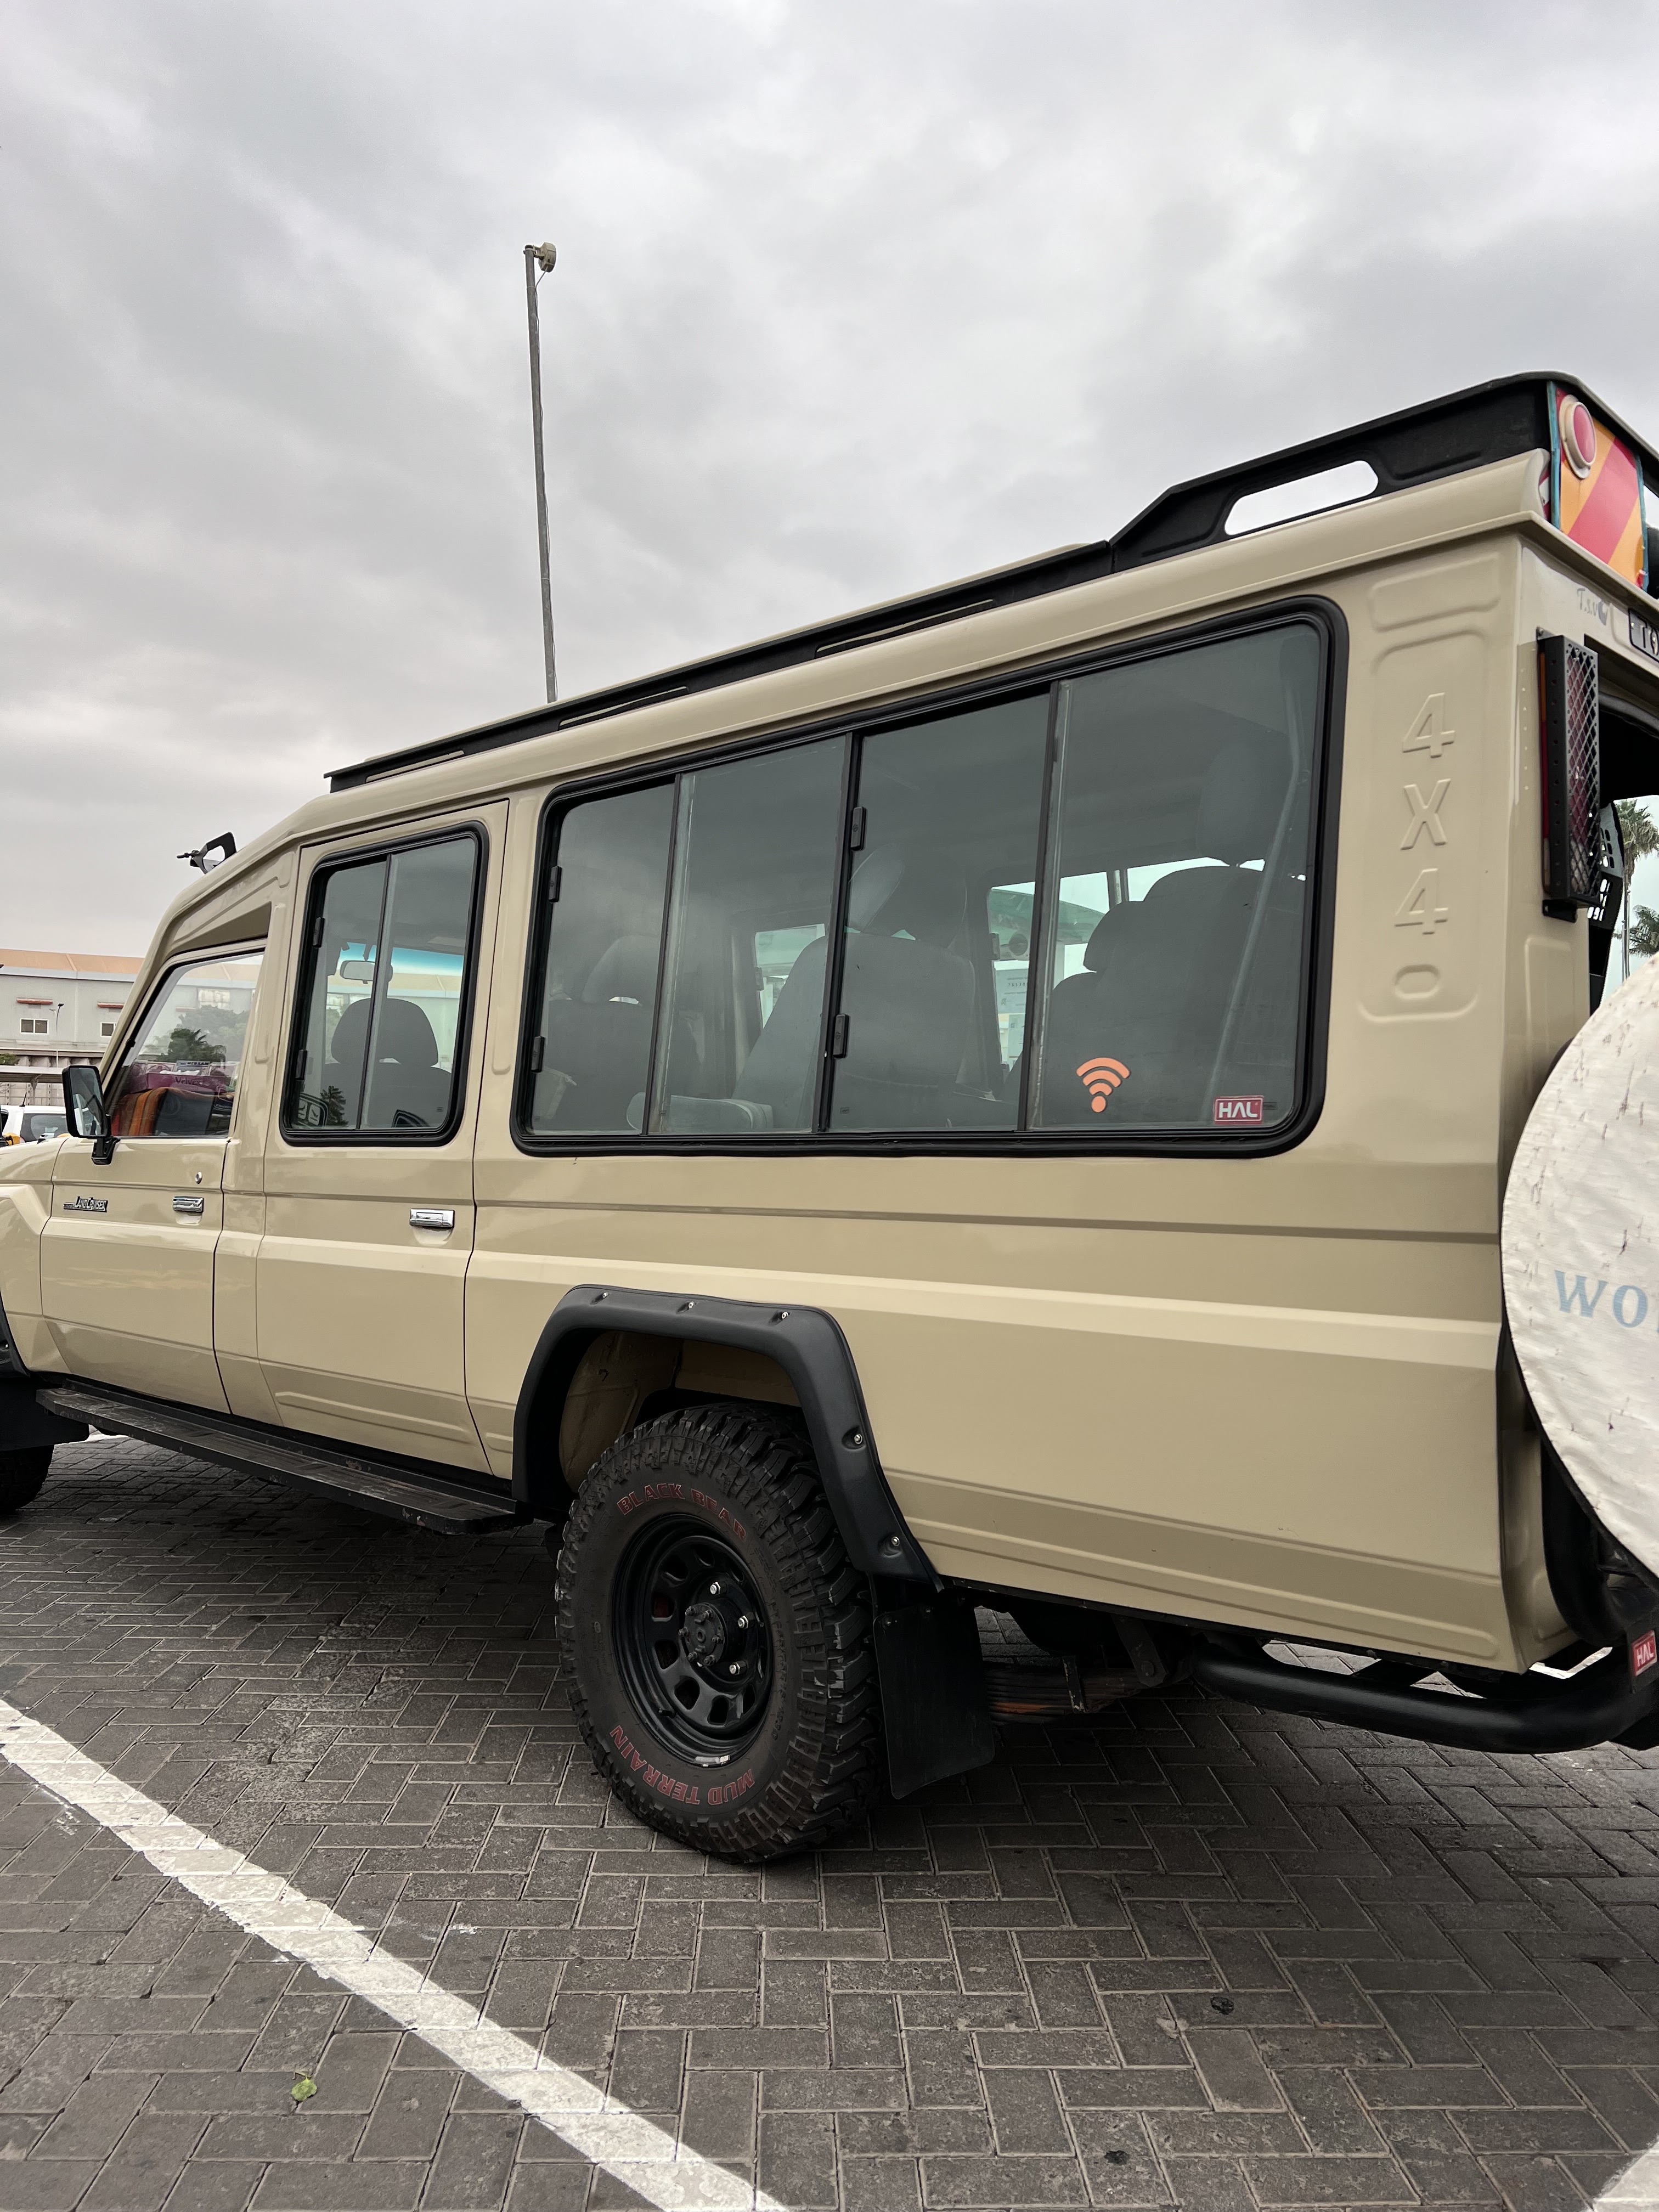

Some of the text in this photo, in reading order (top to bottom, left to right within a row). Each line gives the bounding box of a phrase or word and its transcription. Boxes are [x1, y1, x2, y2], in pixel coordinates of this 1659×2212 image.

[1218, 1102, 1258, 1118] HAL
[1554, 1269, 1659, 1329] WO
[616, 1482, 747, 1545] BLACK BEAR
[1637, 1641, 1654, 1667] HAL
[609, 1725, 755, 1805] MUD TERRAIN
